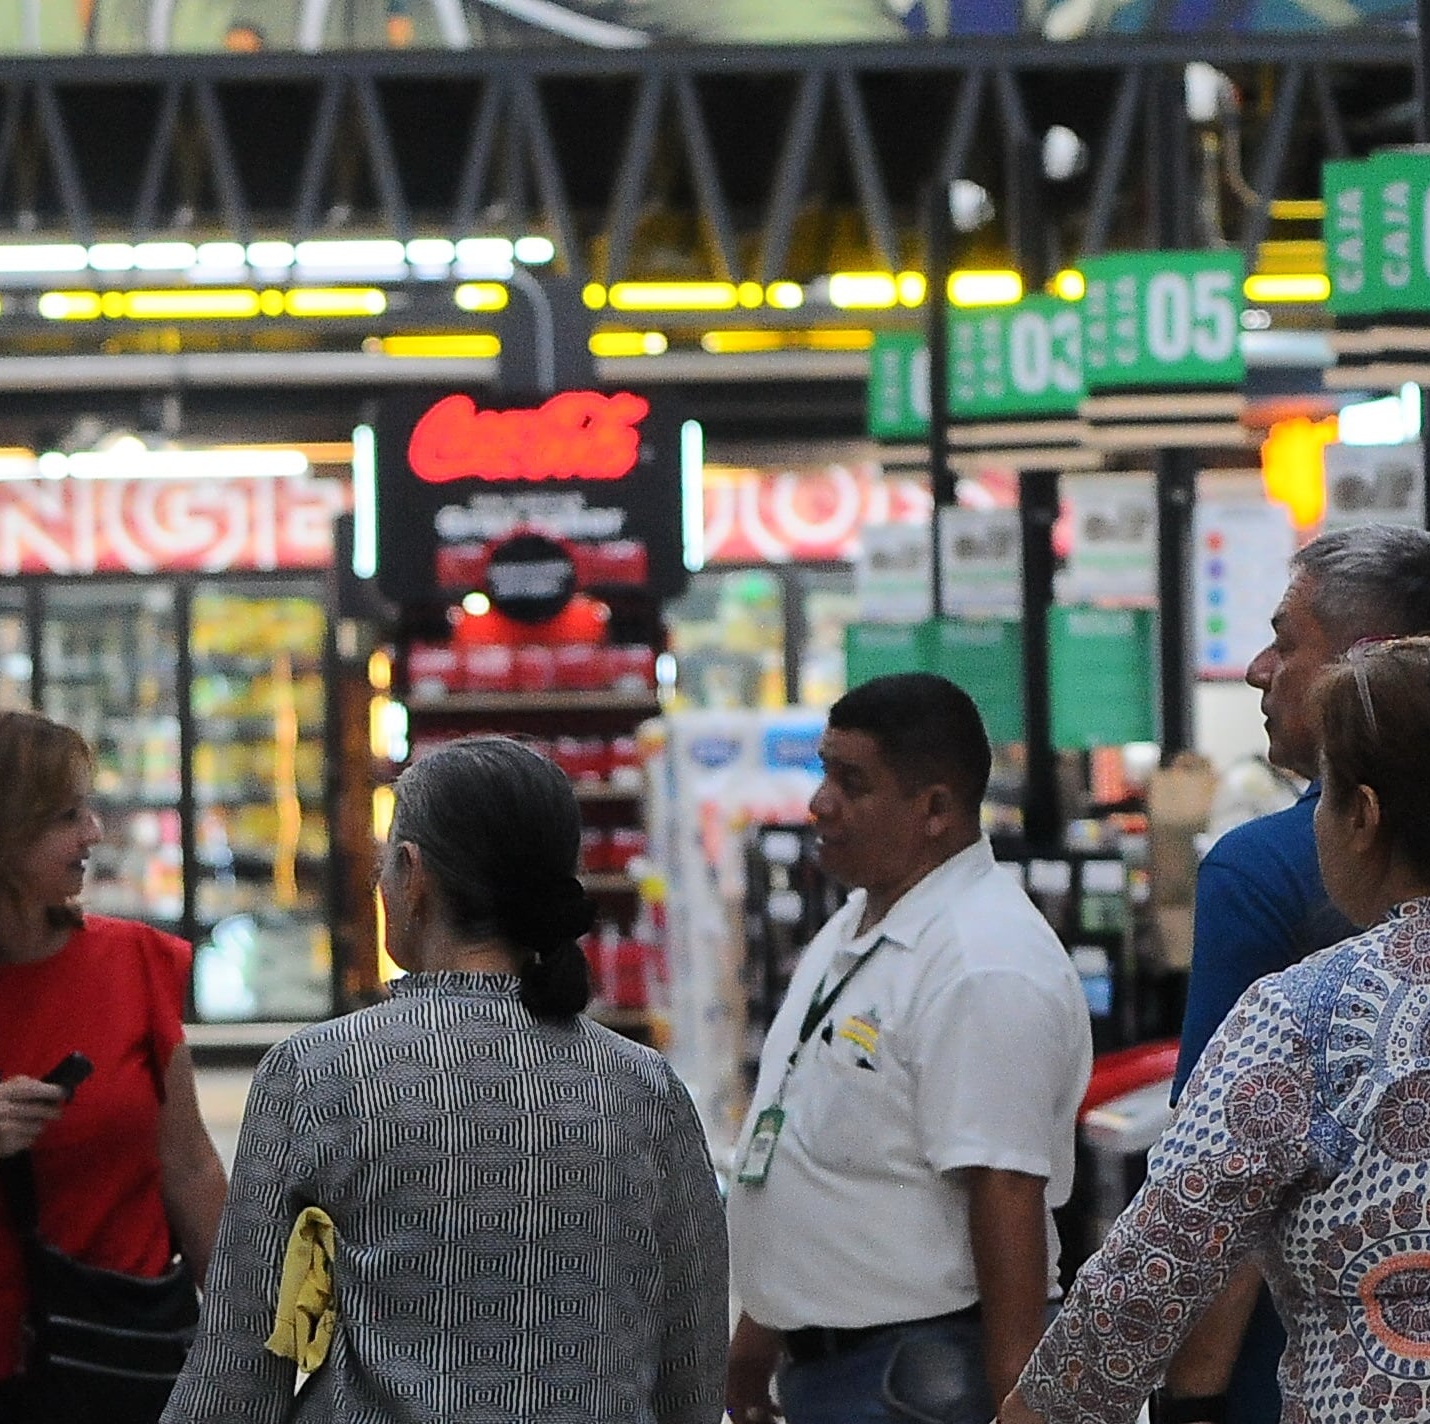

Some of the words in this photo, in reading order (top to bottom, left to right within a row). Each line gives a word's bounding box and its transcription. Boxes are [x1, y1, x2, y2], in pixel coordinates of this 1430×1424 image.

[1337, 189, 1363, 294] CAJA
[1382, 182, 1410, 288] CAJA
[1010, 310, 1082, 395] 03
[1146, 271, 1237, 363] 05
